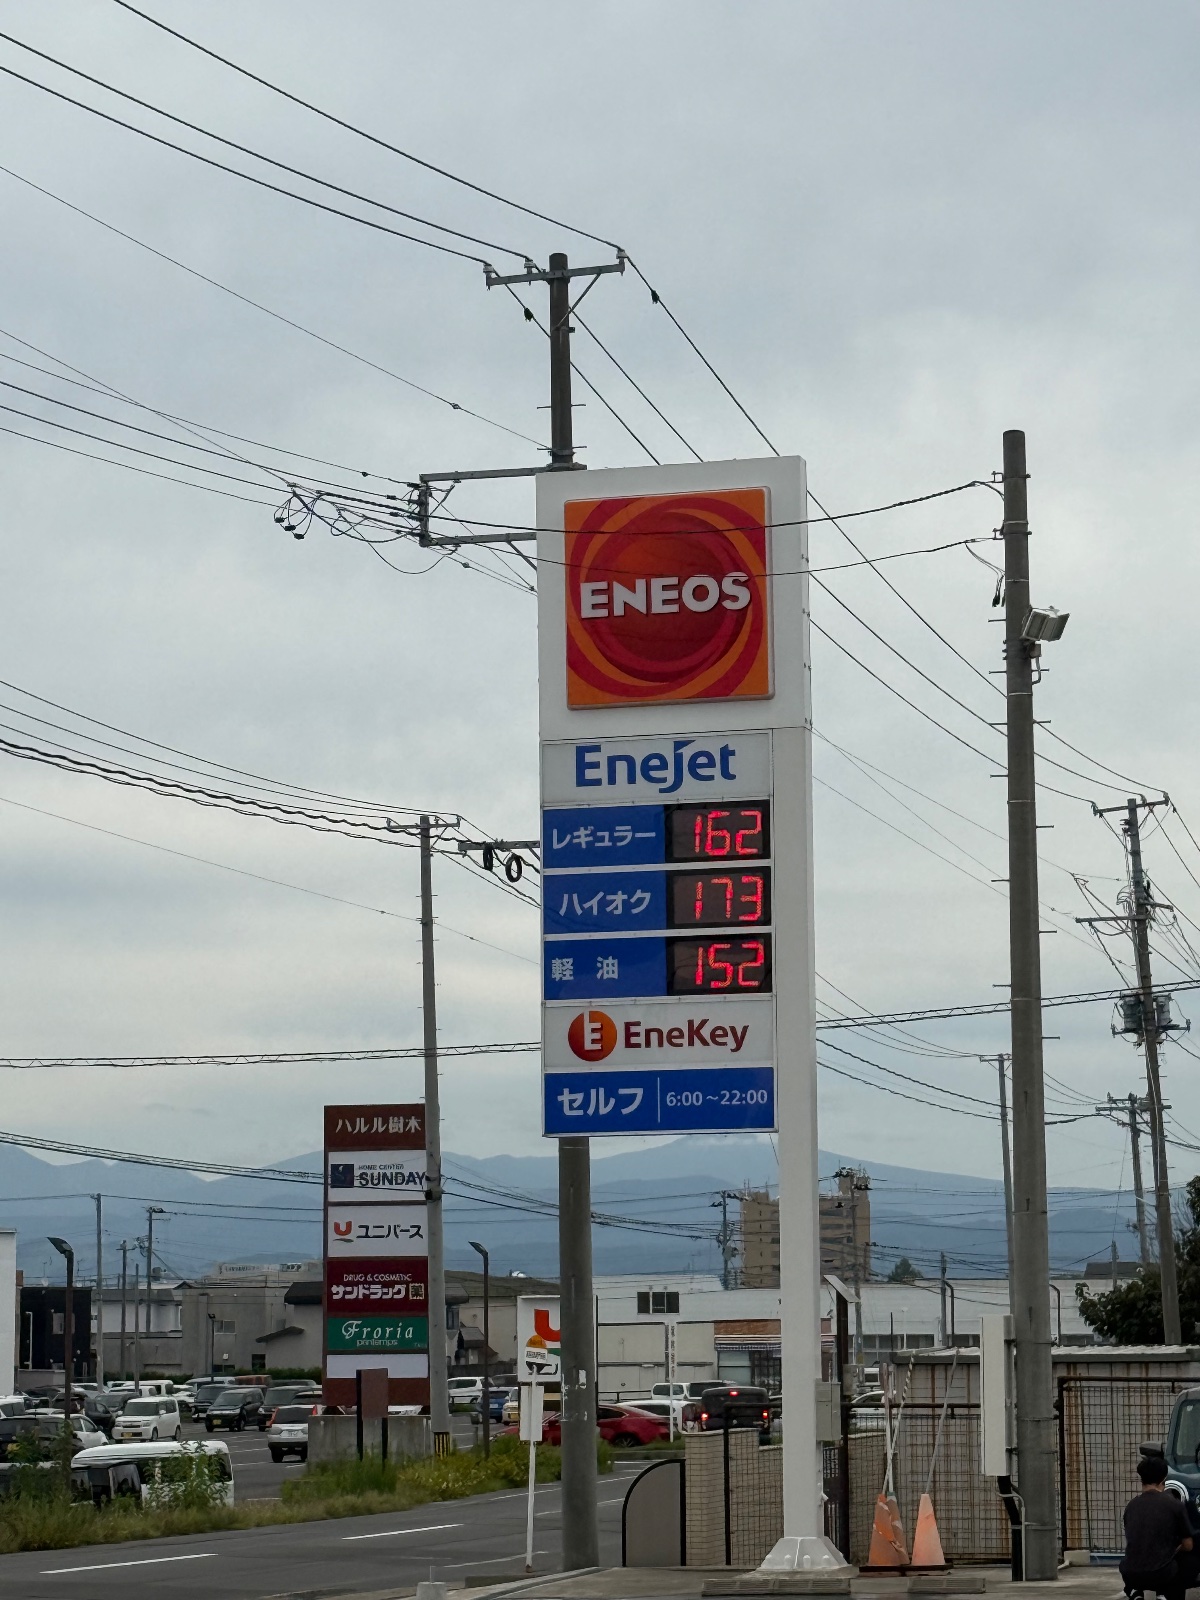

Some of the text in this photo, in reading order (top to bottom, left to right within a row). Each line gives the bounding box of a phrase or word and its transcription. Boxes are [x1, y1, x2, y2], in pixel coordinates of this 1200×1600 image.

[580, 571, 751, 619] ENEOS
[552, 825, 657, 849] レギュラー
[694, 810, 762, 855] 162
[558, 889, 652, 916] ハイオク
[694, 875, 764, 921] 173
[695, 941, 765, 988] 152
[623, 1018, 750, 1053] EneKey
[557, 1087, 644, 1117] セルフ
[335, 1116, 422, 1134] ハルル樹木
[358, 1171, 426, 1187] SUNDAY
[356, 1223, 424, 1239] ユニバース
[343, 1273, 365, 1282] DRUG
[373, 1273, 413, 1282] COSMETIC
[331, 1284, 406, 1300] サンドラッグ
[341, 1320, 414, 1339] Froria
